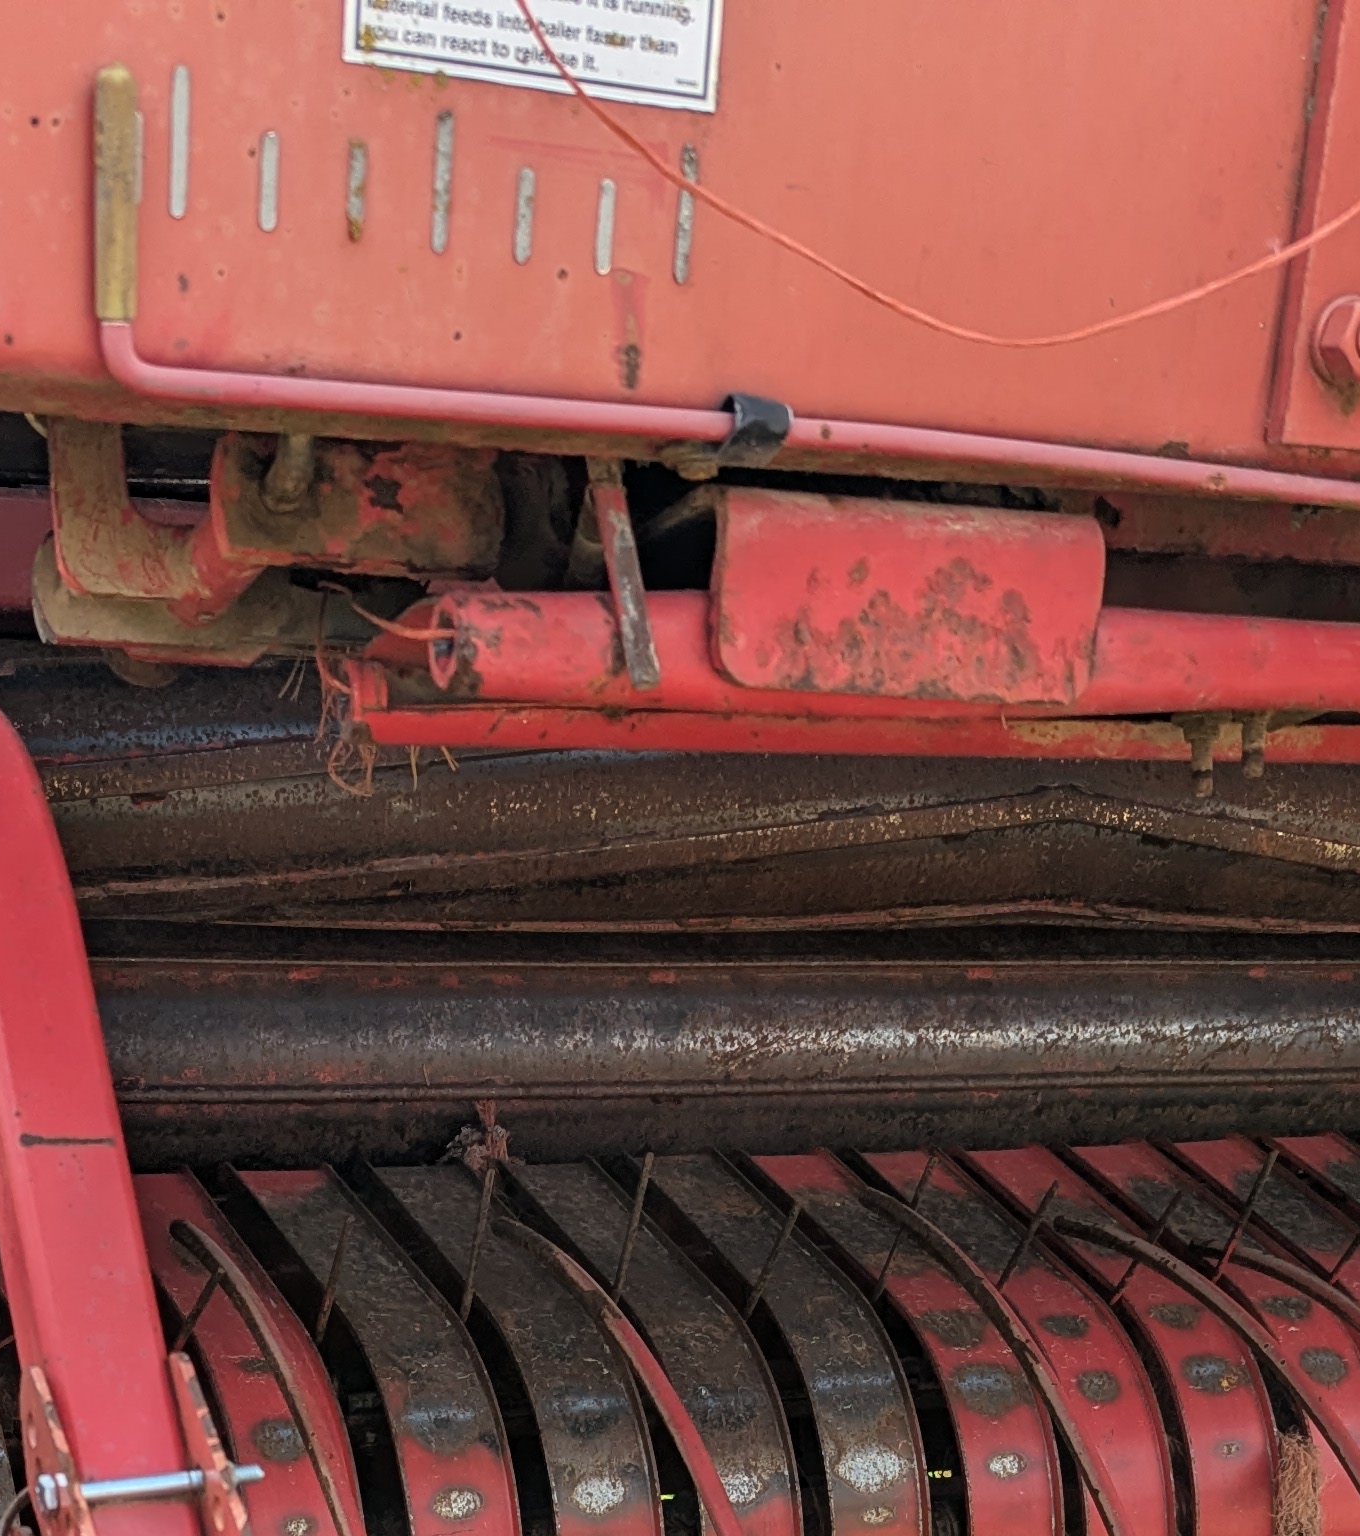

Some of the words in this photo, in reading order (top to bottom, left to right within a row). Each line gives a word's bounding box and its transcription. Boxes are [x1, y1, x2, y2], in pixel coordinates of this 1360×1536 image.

[443, 4, 492, 28] feeds
[623, 0, 695, 27] running.
[403, 29, 436, 48] can
[443, 34, 487, 57] react
[492, 41, 510, 58] to
[514, 44, 578, 69] relese
